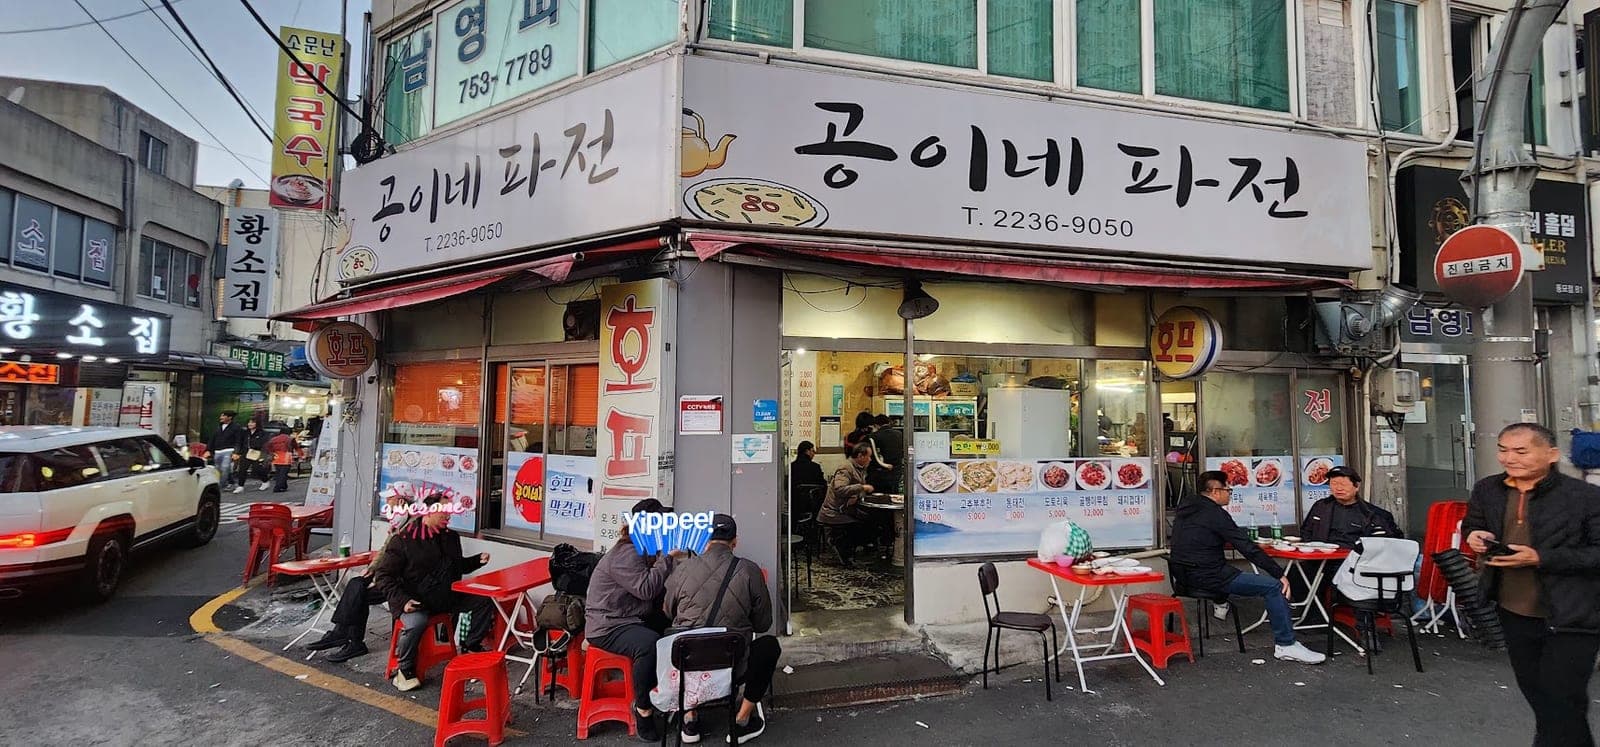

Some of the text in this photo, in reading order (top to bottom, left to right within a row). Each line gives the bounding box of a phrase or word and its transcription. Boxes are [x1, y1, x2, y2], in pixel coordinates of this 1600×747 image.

[286, 34, 336, 57] 소문난
[284, 60, 331, 167] 막국수
[373, 108, 620, 242] 공이네 파전
[795, 102, 1308, 218] 공이네 파전
[425, 221, 504, 253] T. 2236-9050
[961, 205, 1135, 239] T. 2236-9050
[1544, 213, 1575, 238] 홀덤
[230, 214, 270, 314] 황소집
[327, 330, 368, 366] 호프
[1155, 320, 1196, 363] 호프
[251, 350, 266, 370] 건재
[602, 294, 657, 500] 호프
[1304, 388, 1331, 424] 전
[550, 475, 574, 492] 호프
[549, 499, 586, 518] 막걸리
